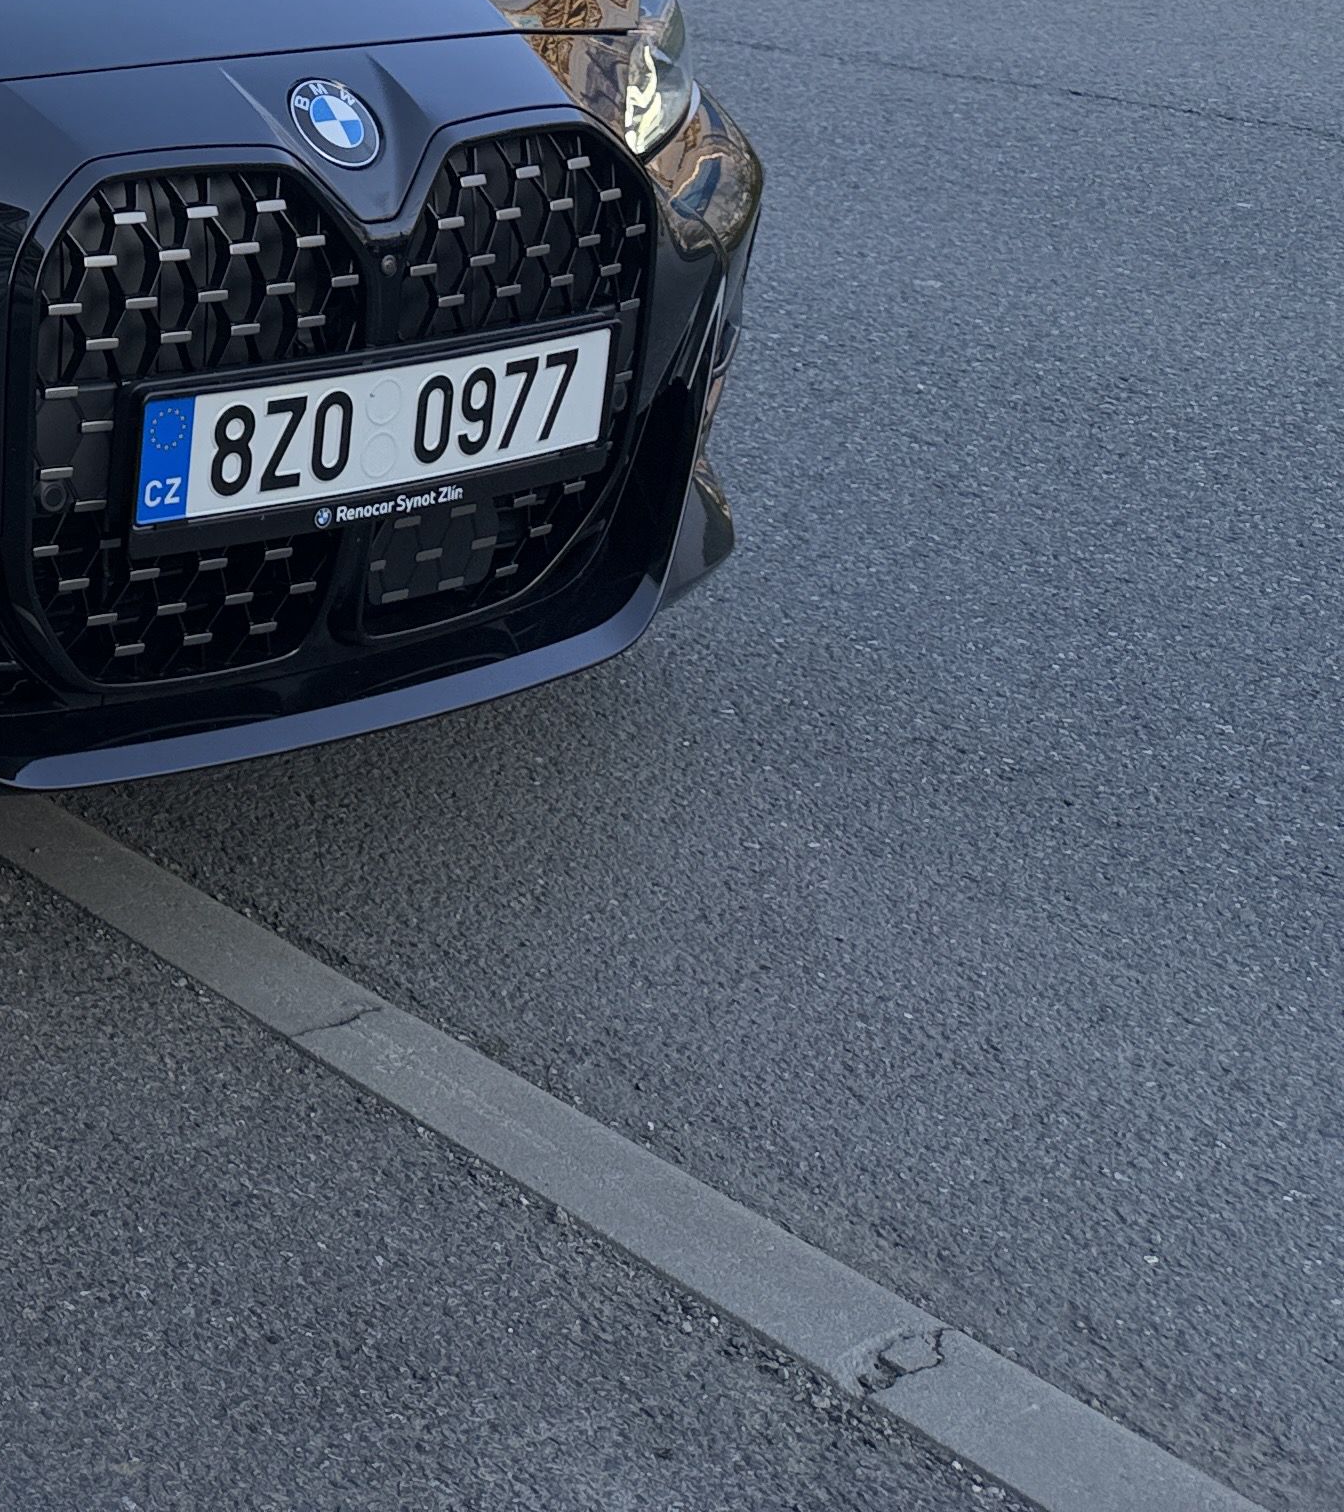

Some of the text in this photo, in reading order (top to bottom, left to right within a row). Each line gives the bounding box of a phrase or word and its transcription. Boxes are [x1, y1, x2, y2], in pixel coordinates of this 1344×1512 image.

[294, 82, 356, 112] BMW
[413, 349, 579, 464] 0977
[143, 476, 183, 509] CZ
[336, 484, 464, 523] Renocar Synot Zlín
